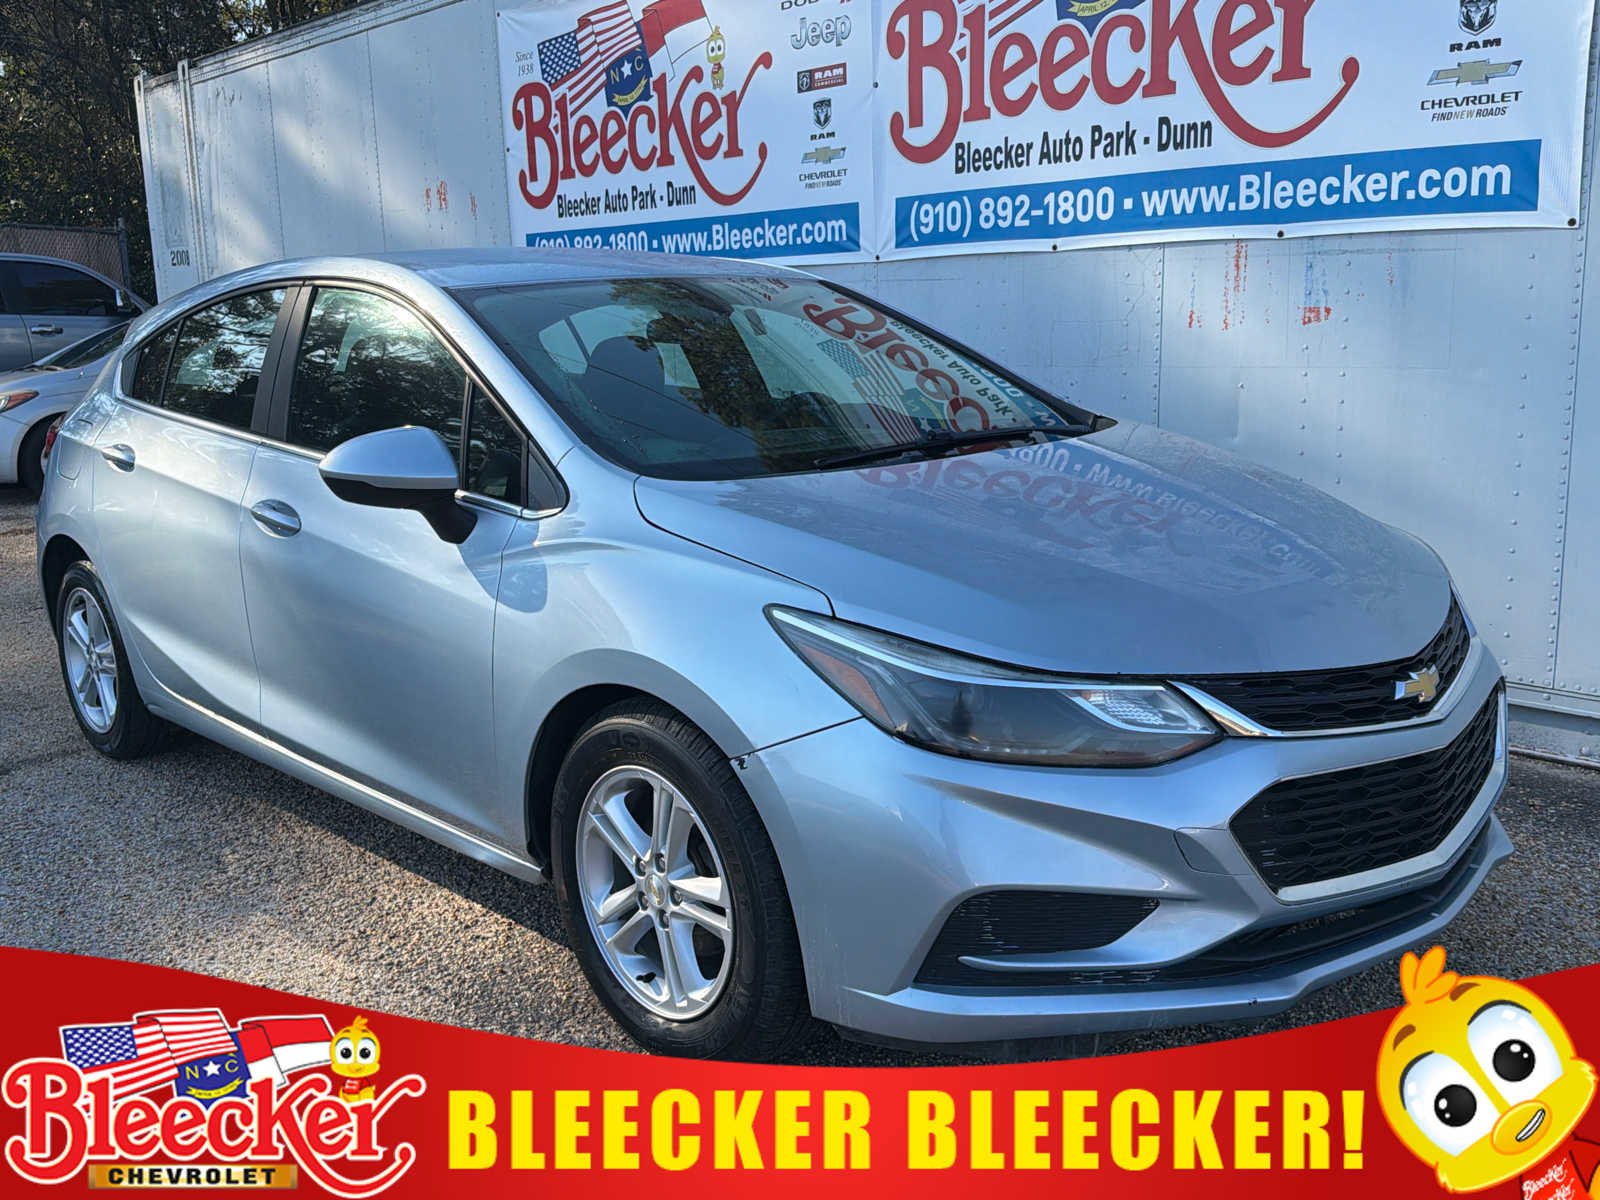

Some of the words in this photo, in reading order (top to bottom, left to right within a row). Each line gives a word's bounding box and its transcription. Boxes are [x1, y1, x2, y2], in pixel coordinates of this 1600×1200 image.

[791, 15, 851, 50] Jeep
[1449, 37, 1502, 52] RAM
[515, 51, 534, 63] Since
[518, 62, 534, 77] 1938
[814, 67, 844, 80] RAM
[886, 0, 1360, 164] Bleecker
[1420, 90, 1523, 111] CHEVROLET
[512, 51, 773, 210] Bleecker
[810, 131, 836, 141] RAM
[955, 136, 1034, 175] Bleecker
[1038, 130, 1084, 166] Auto
[1090, 121, 1137, 160] Park
[1157, 116, 1213, 153] Dunn
[799, 168, 848, 182] CHEVROLET
[556, 190, 602, 219] Bleecker
[604, 188, 629, 214] Auto
[631, 183, 657, 211] Park
[666, 180, 697, 207] Dunn
[910, 195, 972, 242] (910)
[979, 186, 1114, 229] 892-1800
[1141, 163, 1512, 218] www.Bleecker.com
[661, 217, 847, 254] www.Bleecker.com
